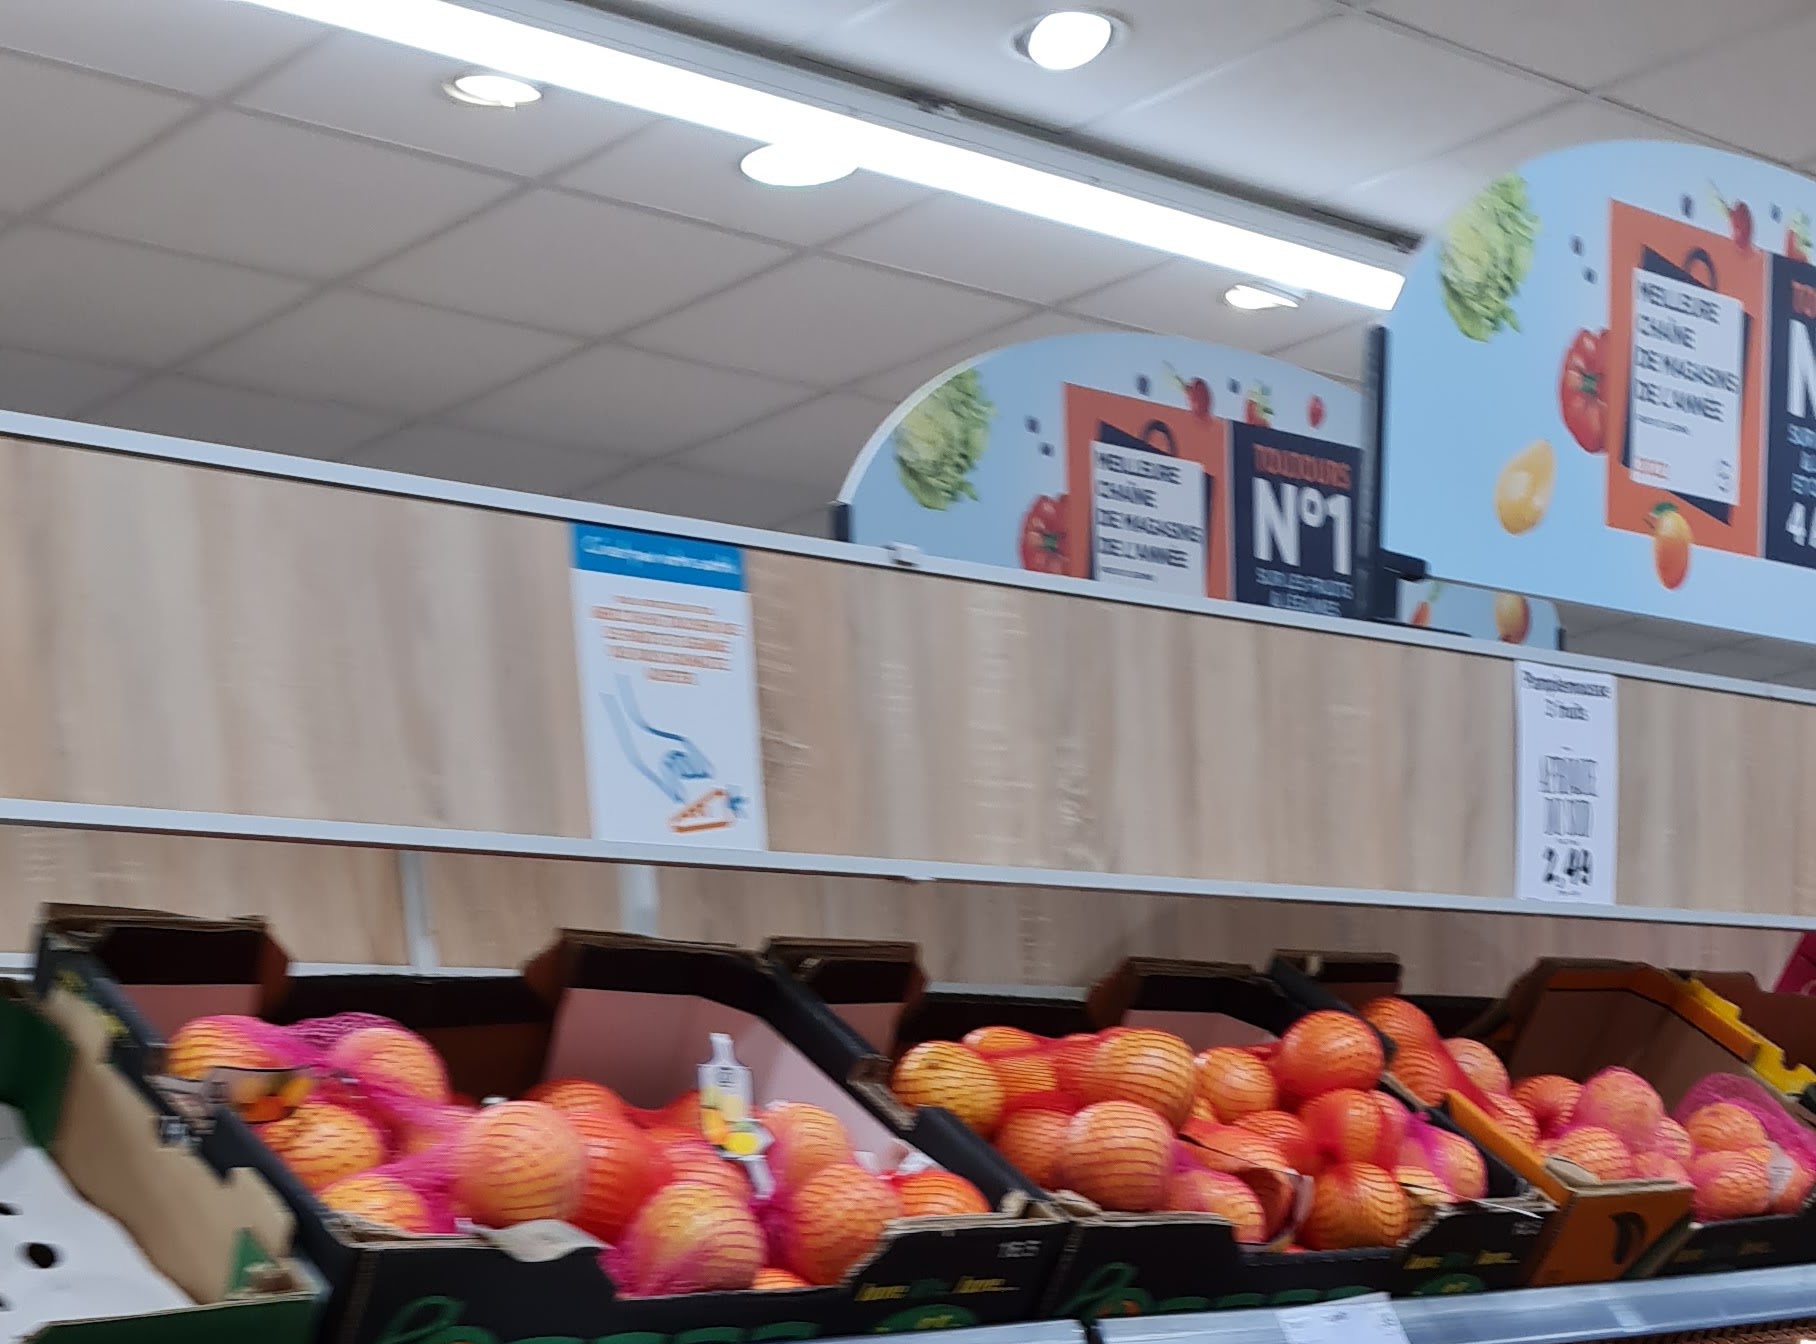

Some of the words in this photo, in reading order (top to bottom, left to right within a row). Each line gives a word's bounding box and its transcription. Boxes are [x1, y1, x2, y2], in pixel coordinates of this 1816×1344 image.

[1638, 281, 1721, 325] MEILLEURE
[1634, 345, 1660, 372] DE
[1662, 353, 1740, 393] MAGASINS
[1634, 378, 1660, 404] DE
[1096, 450, 1182, 485] MEILLEURE
[1253, 443, 1352, 490] TOUJOURS
[1096, 507, 1122, 530] DE
[1123, 511, 1204, 544] MAGASINS
[1097, 536, 1121, 560] DE
